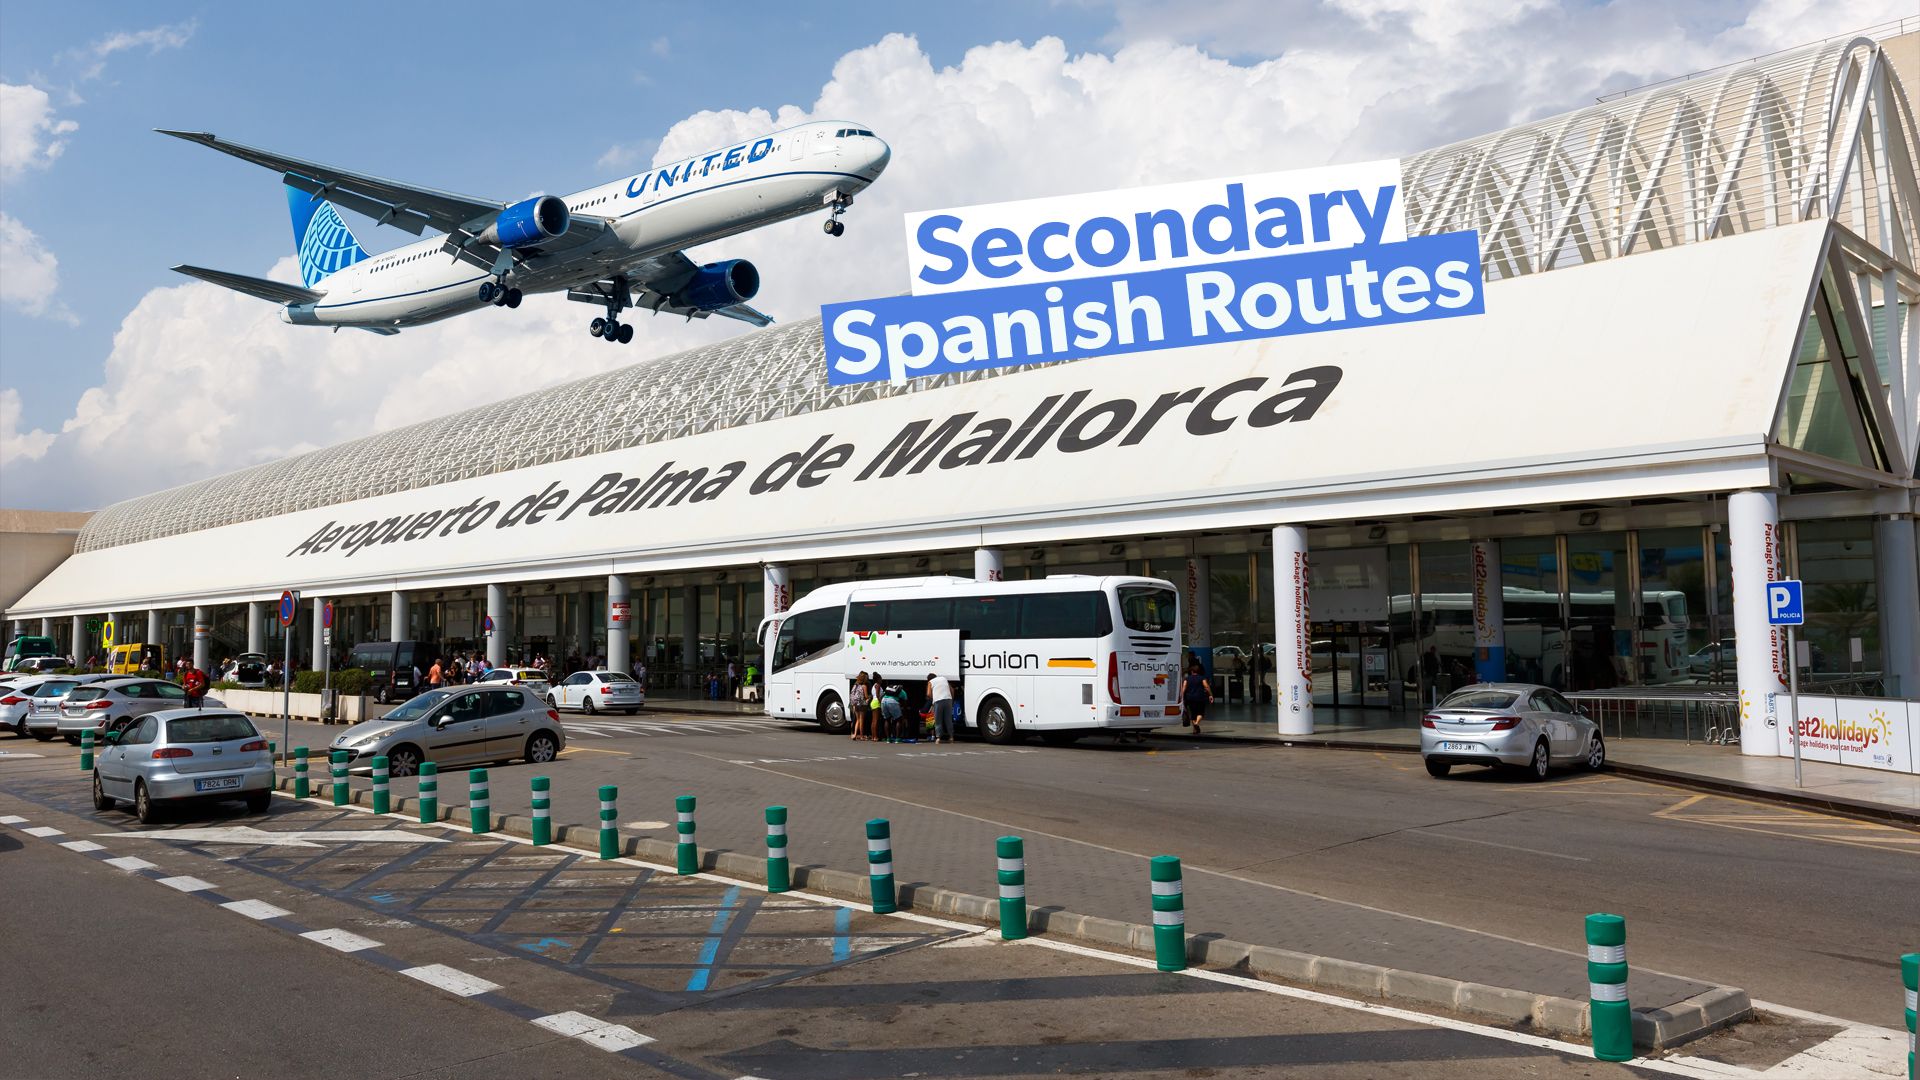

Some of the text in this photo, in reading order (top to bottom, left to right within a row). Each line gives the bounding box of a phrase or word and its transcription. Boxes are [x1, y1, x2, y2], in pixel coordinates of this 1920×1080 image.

[625, 138, 774, 199] UNITED
[286, 364, 1344, 557] Aeropuerto de Palma de Mallorca
[1764, 523, 1773, 565] Package
[1770, 587, 1790, 619] P
[1120, 660, 1180, 672] Transunion
[1770, 628, 1780, 673] can trust
[202, 780, 220, 788] 7824
